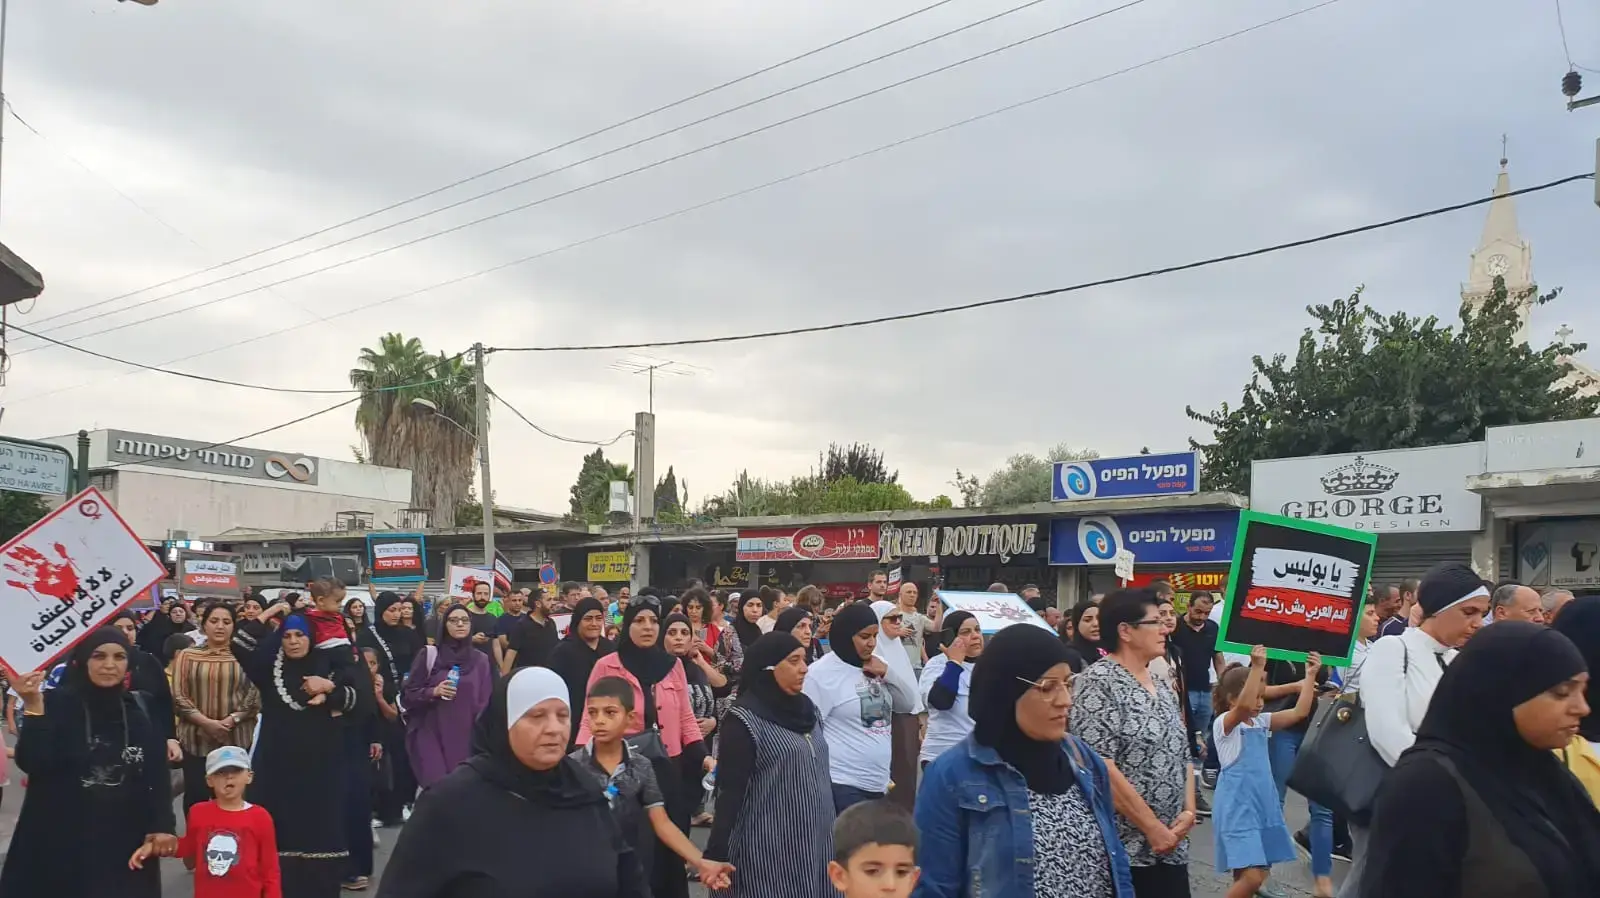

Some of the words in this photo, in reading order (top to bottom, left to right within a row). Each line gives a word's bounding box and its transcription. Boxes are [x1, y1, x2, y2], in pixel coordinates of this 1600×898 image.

[18, 450, 48, 463] הגדוד
[115, 438, 191, 461] טפחות
[197, 449, 255, 470] מזרחי
[1100, 466, 1139, 482] הפיס
[1141, 463, 1187, 481] מפעל
[1280, 494, 1443, 519] GEORGE
[1355, 519, 1451, 530] DESIGN
[940, 523, 1038, 564] BOUTIQUE
[1128, 529, 1167, 544] הפיס
[1169, 527, 1216, 543] מפעל
[97, 566, 113, 582] لا
[1197, 573, 1224, 586] וטו
[1273, 558, 1328, 586] بوليس
[1330, 561, 1342, 588] يا
[72, 584, 88, 600] لا
[85, 575, 100, 591] لا
[109, 573, 134, 606] نعم
[31, 594, 75, 631] للعنف
[80, 594, 106, 628] نعم
[1247, 594, 1285, 615] رخيص
[1284, 598, 1306, 615] مش
[1305, 602, 1332, 622] العربي
[1331, 607, 1348, 623] الدم
[29, 615, 77, 653] للحياة
